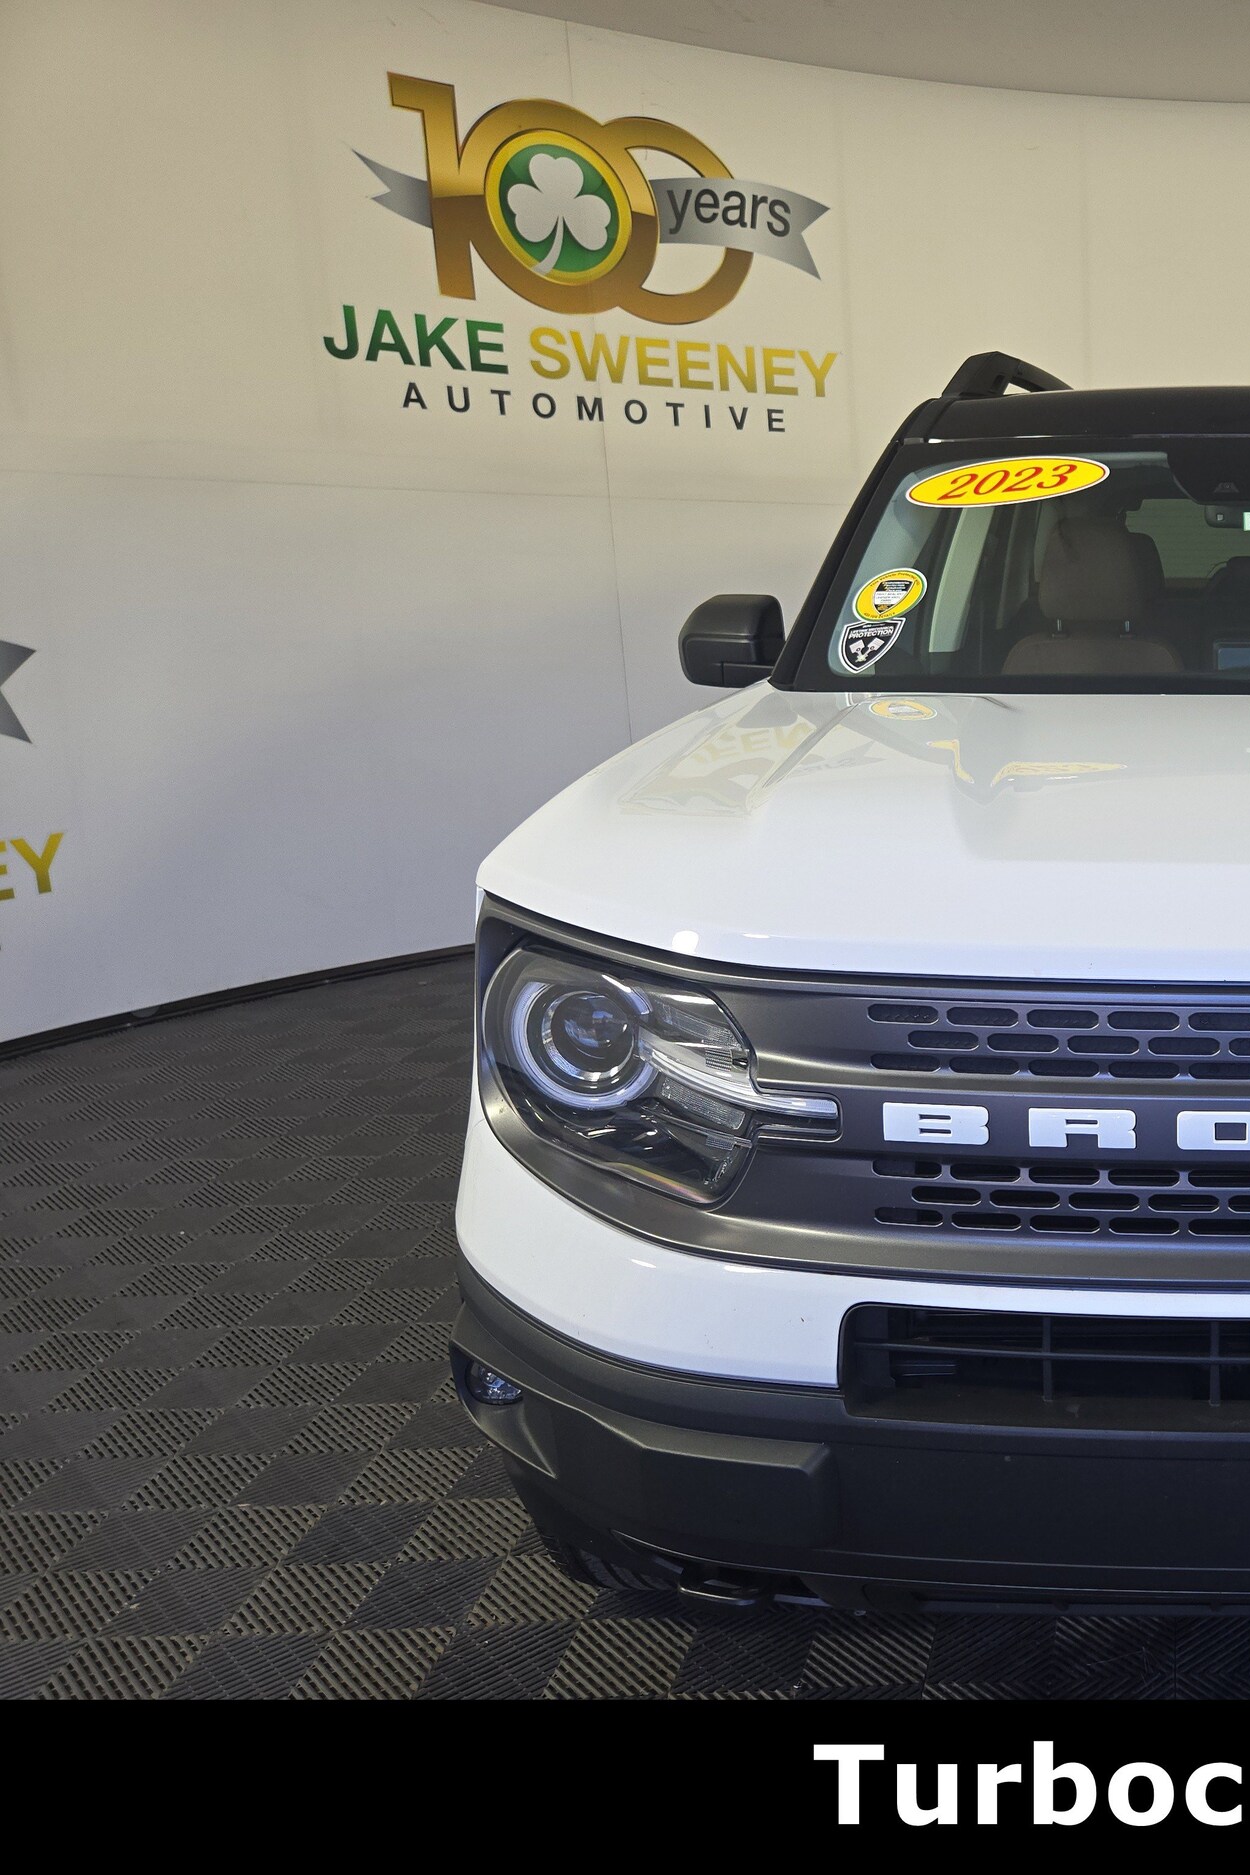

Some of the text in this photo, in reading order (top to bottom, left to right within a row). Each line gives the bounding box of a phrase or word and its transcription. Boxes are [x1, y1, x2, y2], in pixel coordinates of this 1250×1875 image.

[667, 188, 792, 237] years
[323, 304, 838, 398] JAKE SWEENEY
[402, 382, 785, 432] AUTOMOTIVE
[937, 463, 1077, 501] 2023
